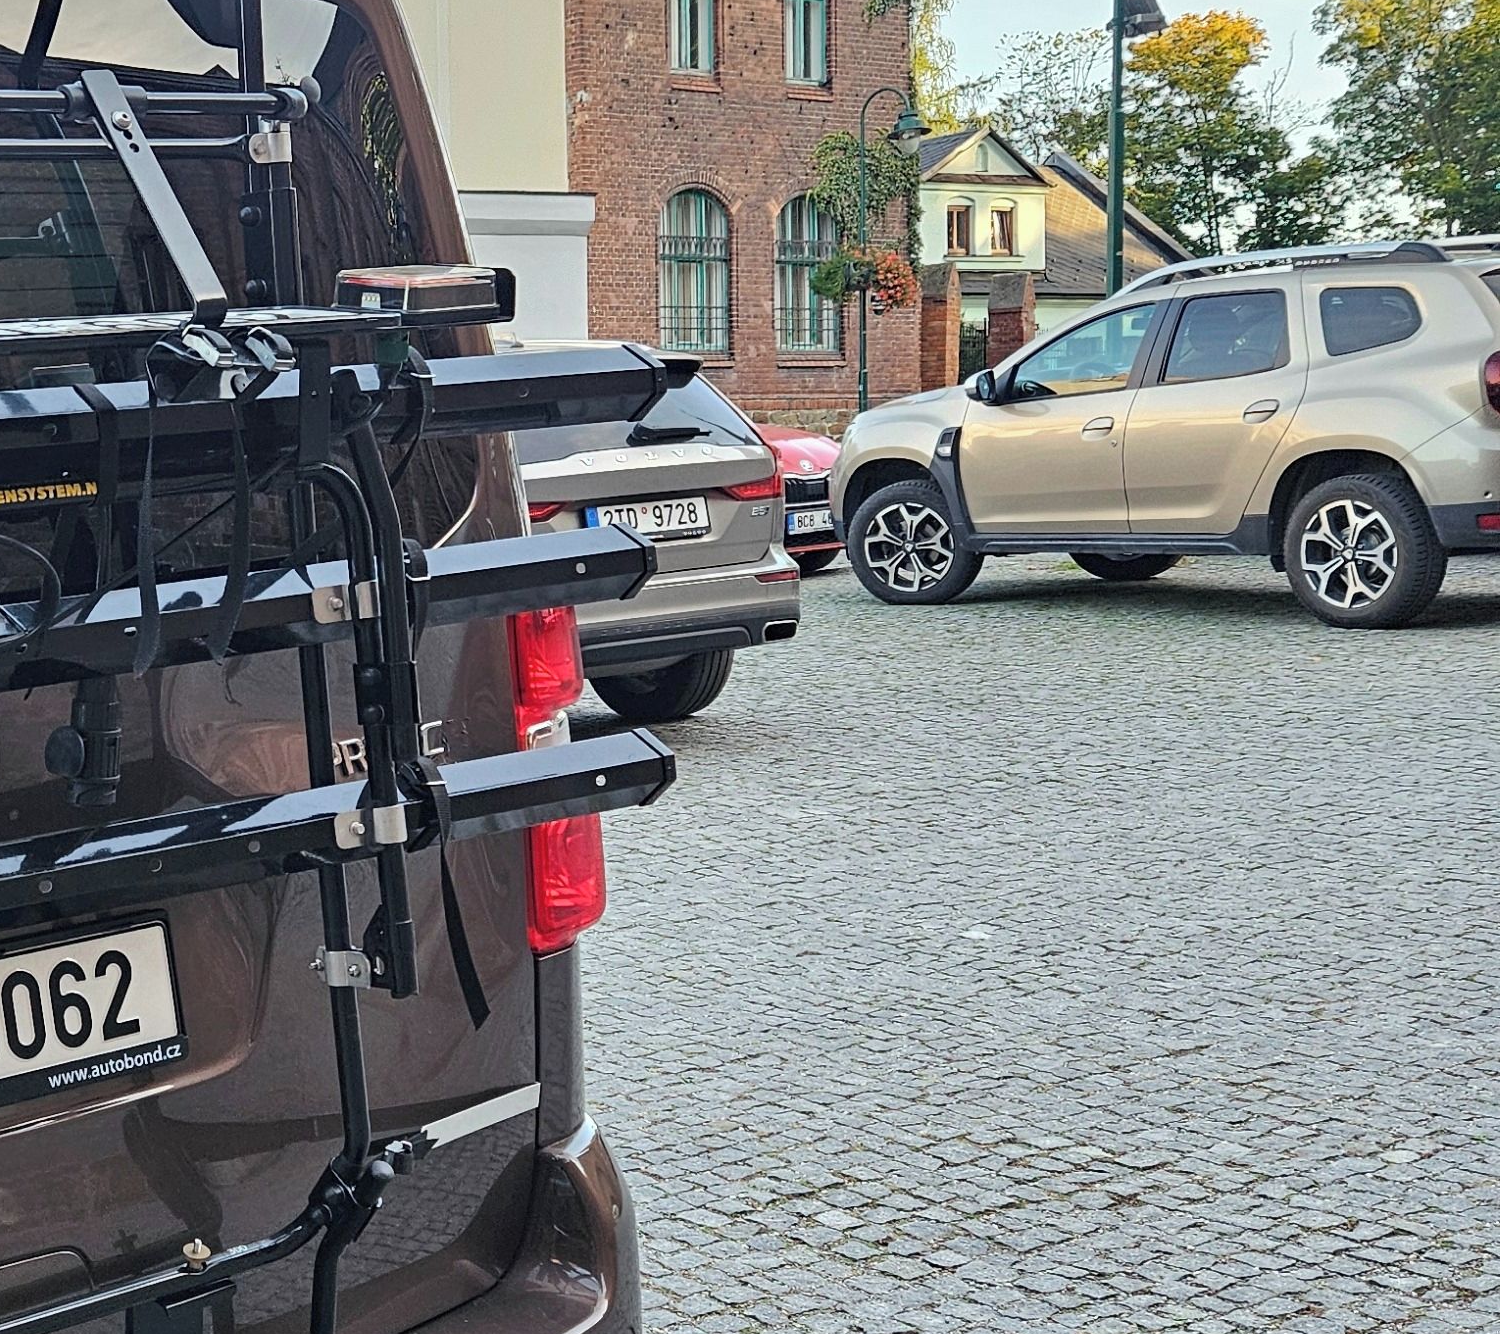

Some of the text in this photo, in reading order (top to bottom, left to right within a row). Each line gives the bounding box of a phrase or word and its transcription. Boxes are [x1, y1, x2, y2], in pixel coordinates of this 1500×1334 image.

[580, 446, 714, 467] VOLVO
[603, 502, 699, 530] 2TD 9728
[48, 1044, 182, 1089] www.autobond.cz
